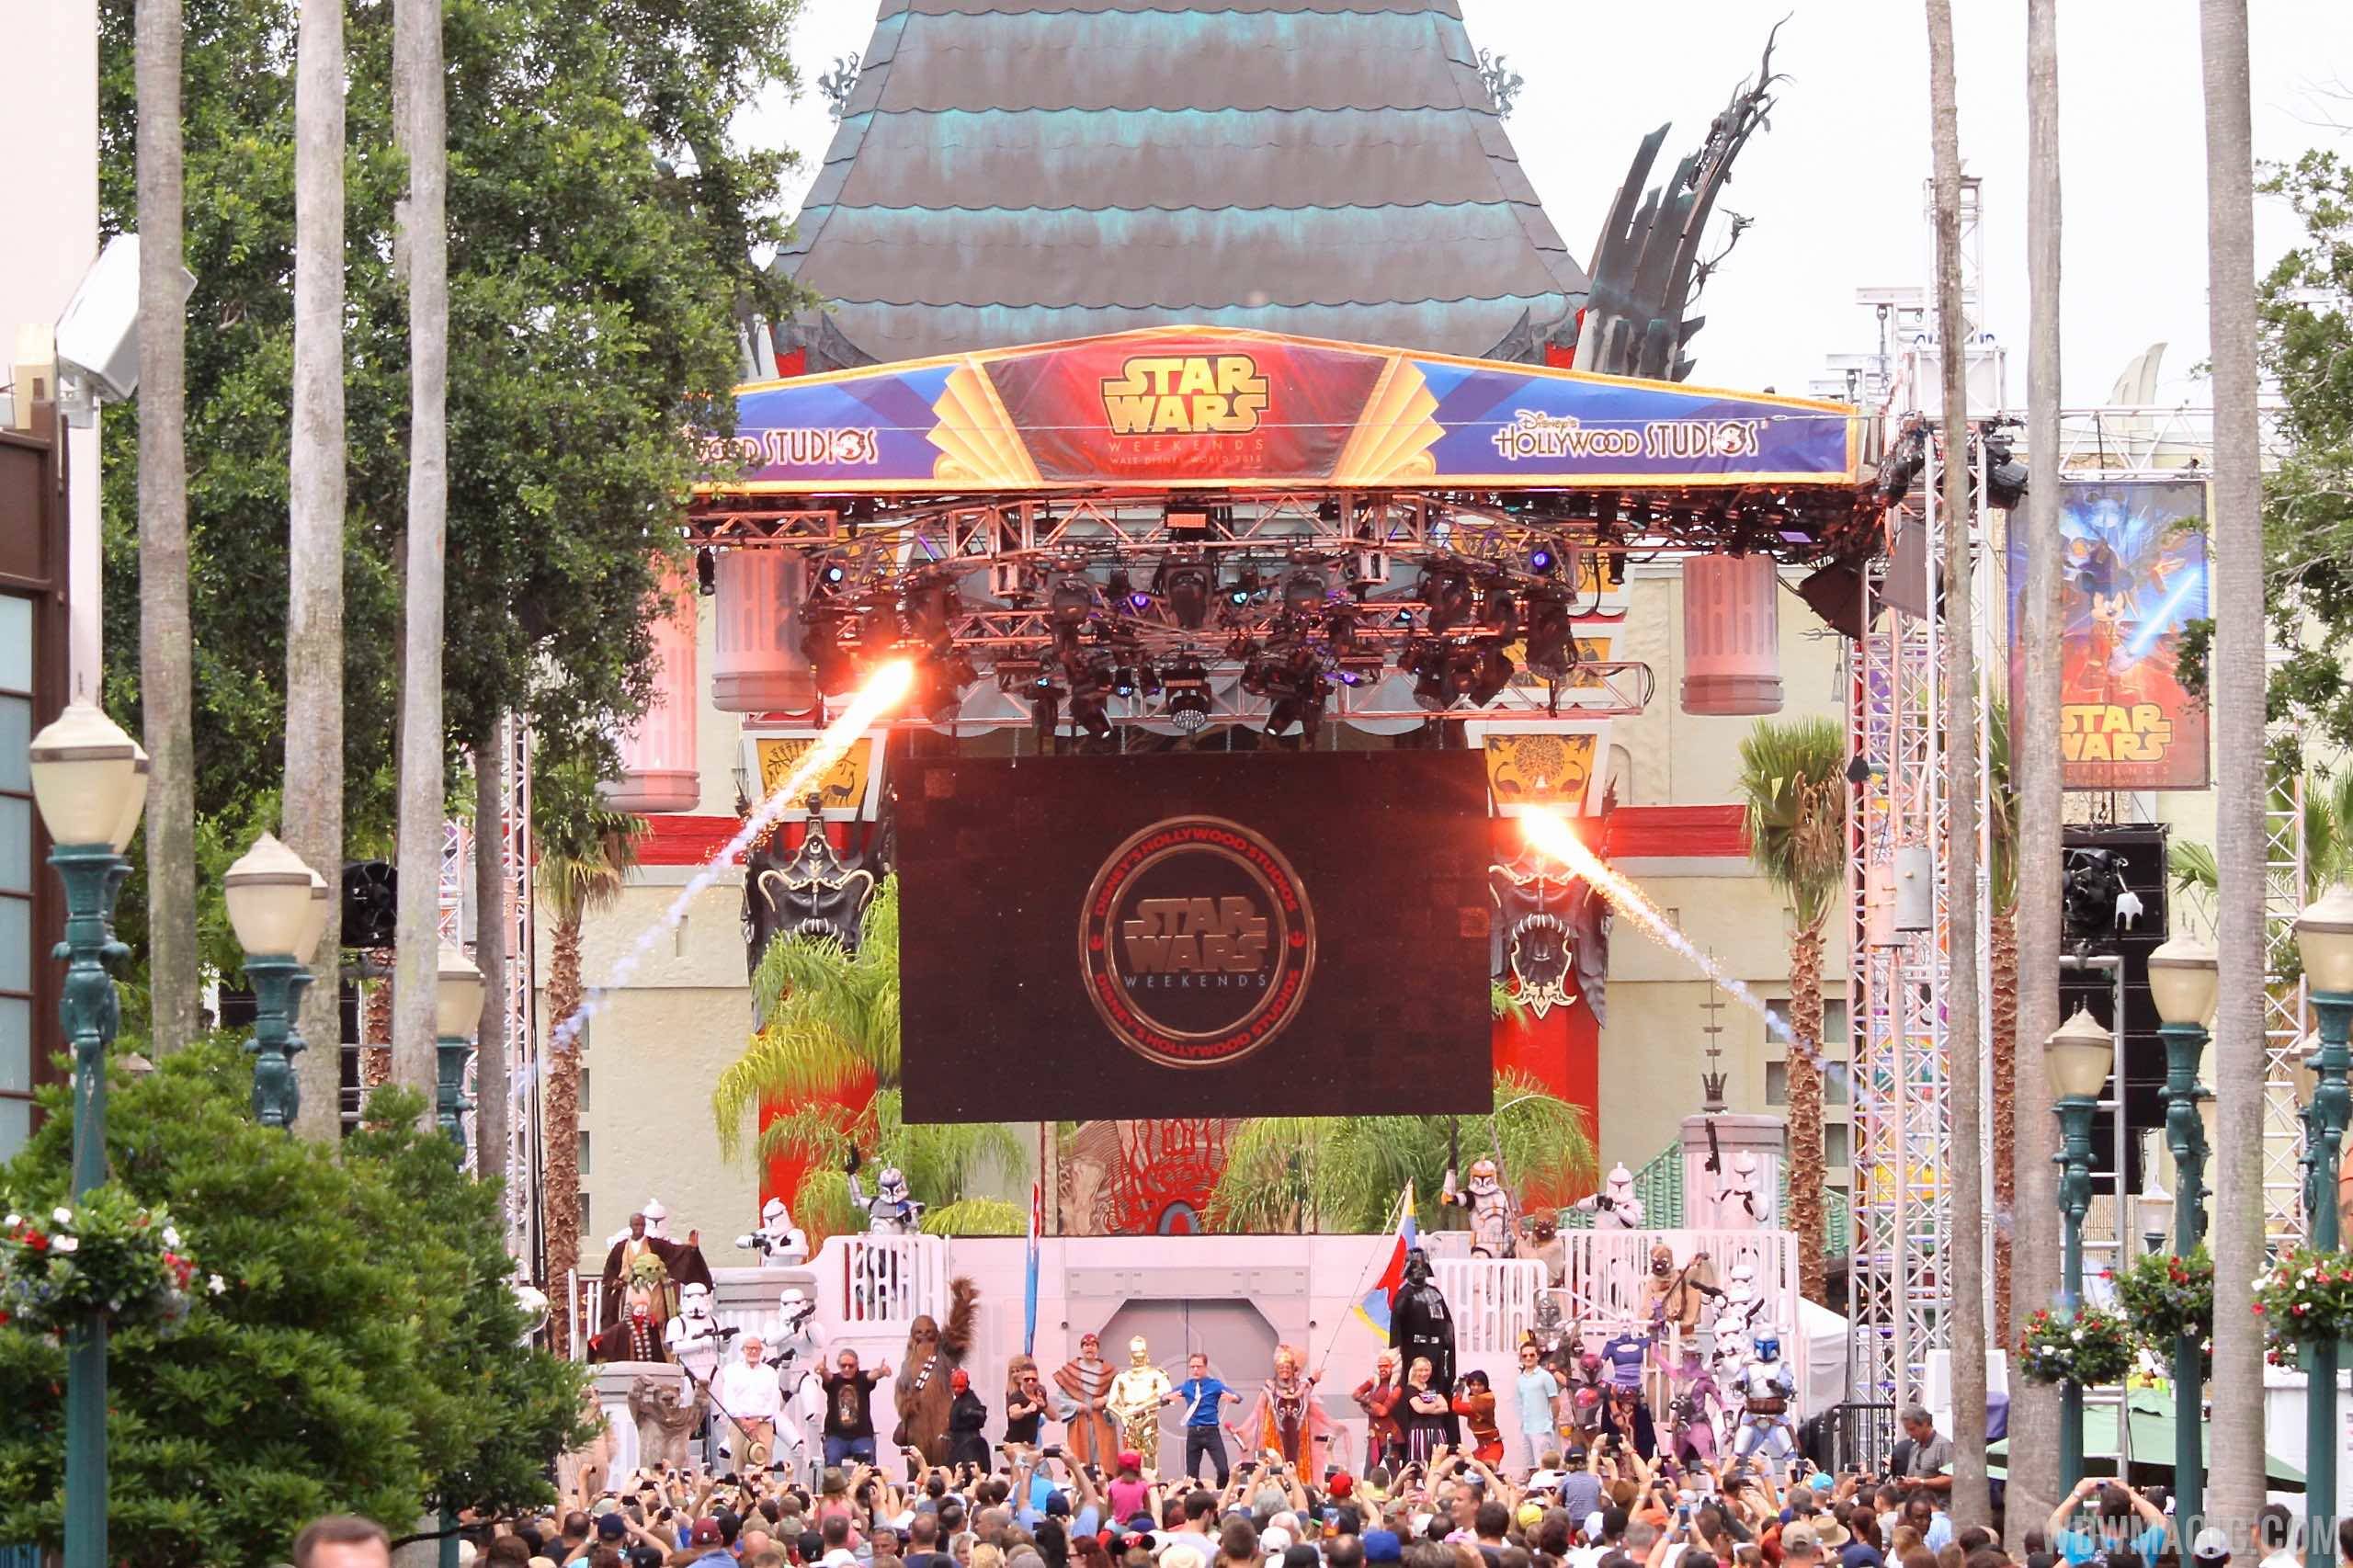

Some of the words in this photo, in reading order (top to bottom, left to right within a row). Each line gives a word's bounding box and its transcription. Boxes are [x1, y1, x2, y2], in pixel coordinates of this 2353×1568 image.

[1102, 356, 1267, 395] STAR
[1103, 393, 1267, 434] WARS
[766, 428, 878, 462] STUDIOS
[1108, 438, 1265, 452] WEEKENDS
[1495, 425, 1640, 458] HOLLYWOOD
[1645, 423, 1757, 455] STUDIOS
[2060, 704, 2172, 733] STAR
[1141, 827, 1247, 854] HOLLYWOOD
[1247, 846, 1298, 913] STUDIOS
[1123, 896, 1267, 936] STAR
[1123, 934, 1268, 972] WARS
[1124, 974, 1266, 989] WEEKENDS
[1146, 1030, 1251, 1057] HOLLYWOOD
[1250, 969, 1301, 1037] STUDIOS
